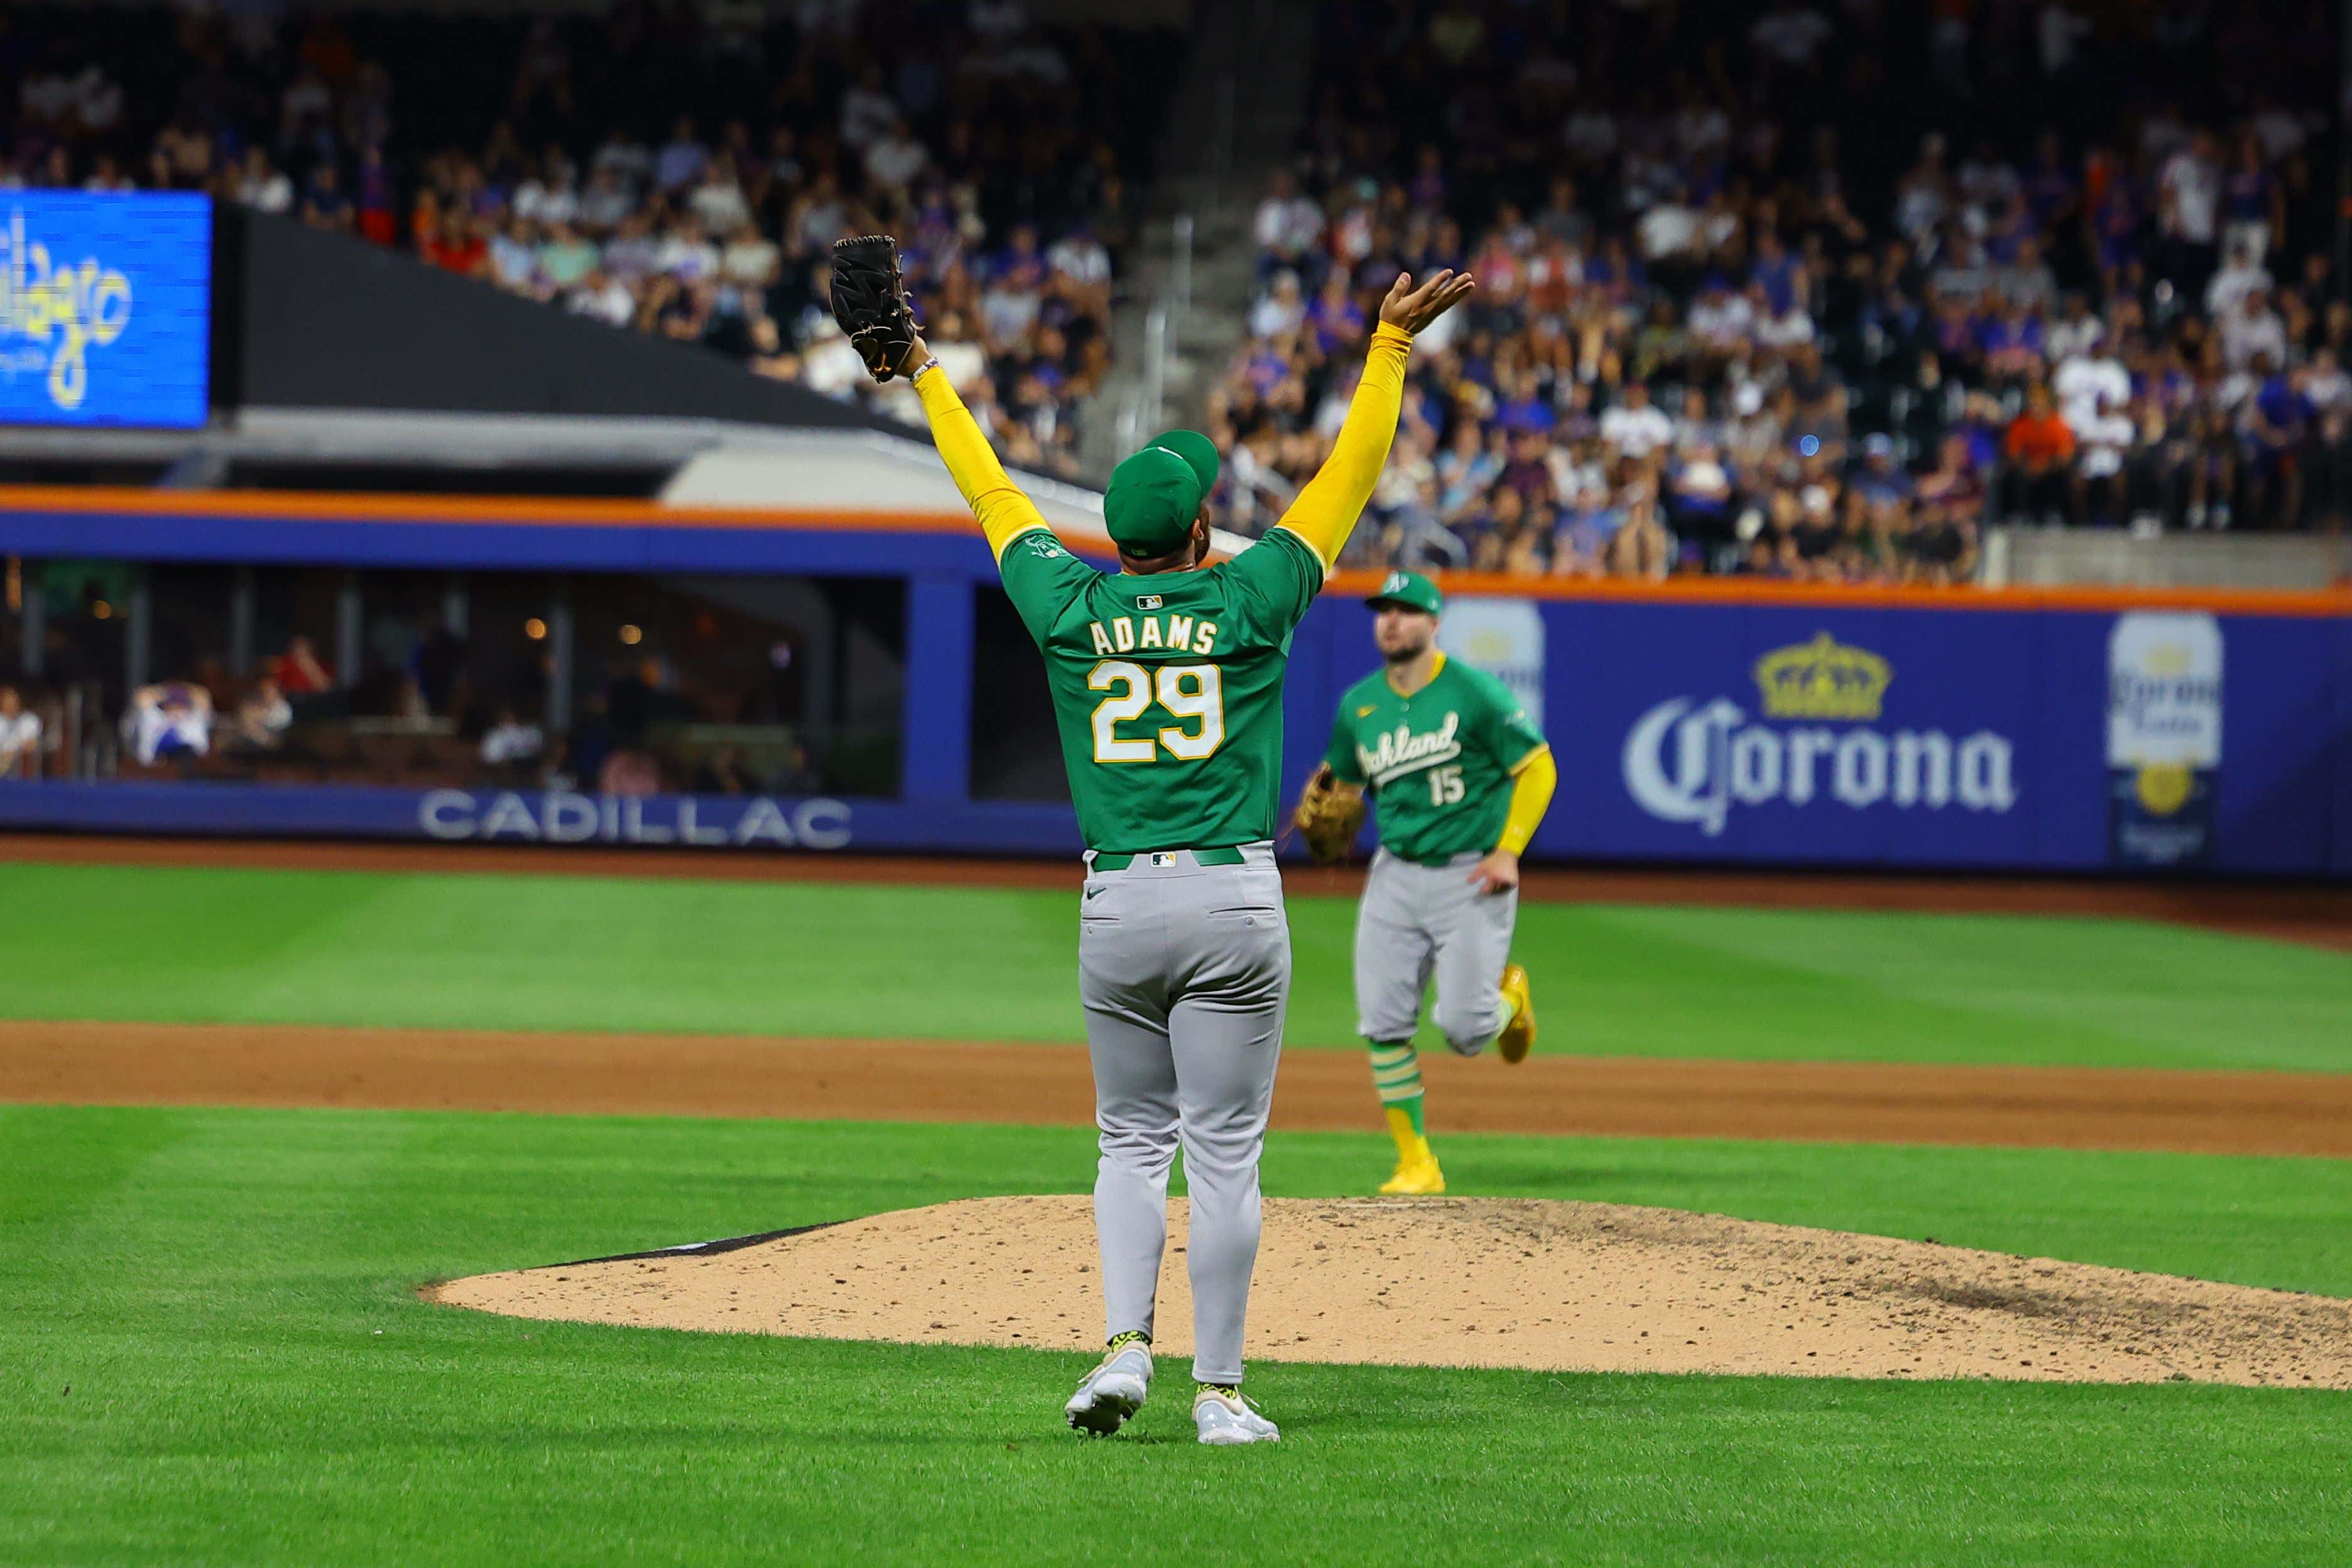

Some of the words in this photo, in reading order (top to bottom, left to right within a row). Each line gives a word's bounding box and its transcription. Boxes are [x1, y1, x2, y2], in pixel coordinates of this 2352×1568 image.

[1089, 614, 1218, 656] ADAMS
[1087, 659, 1226, 763] 29
[1429, 765, 1465, 806] 15
[1621, 695, 2018, 837] Corona
[419, 787, 852, 849] CADILLAC
